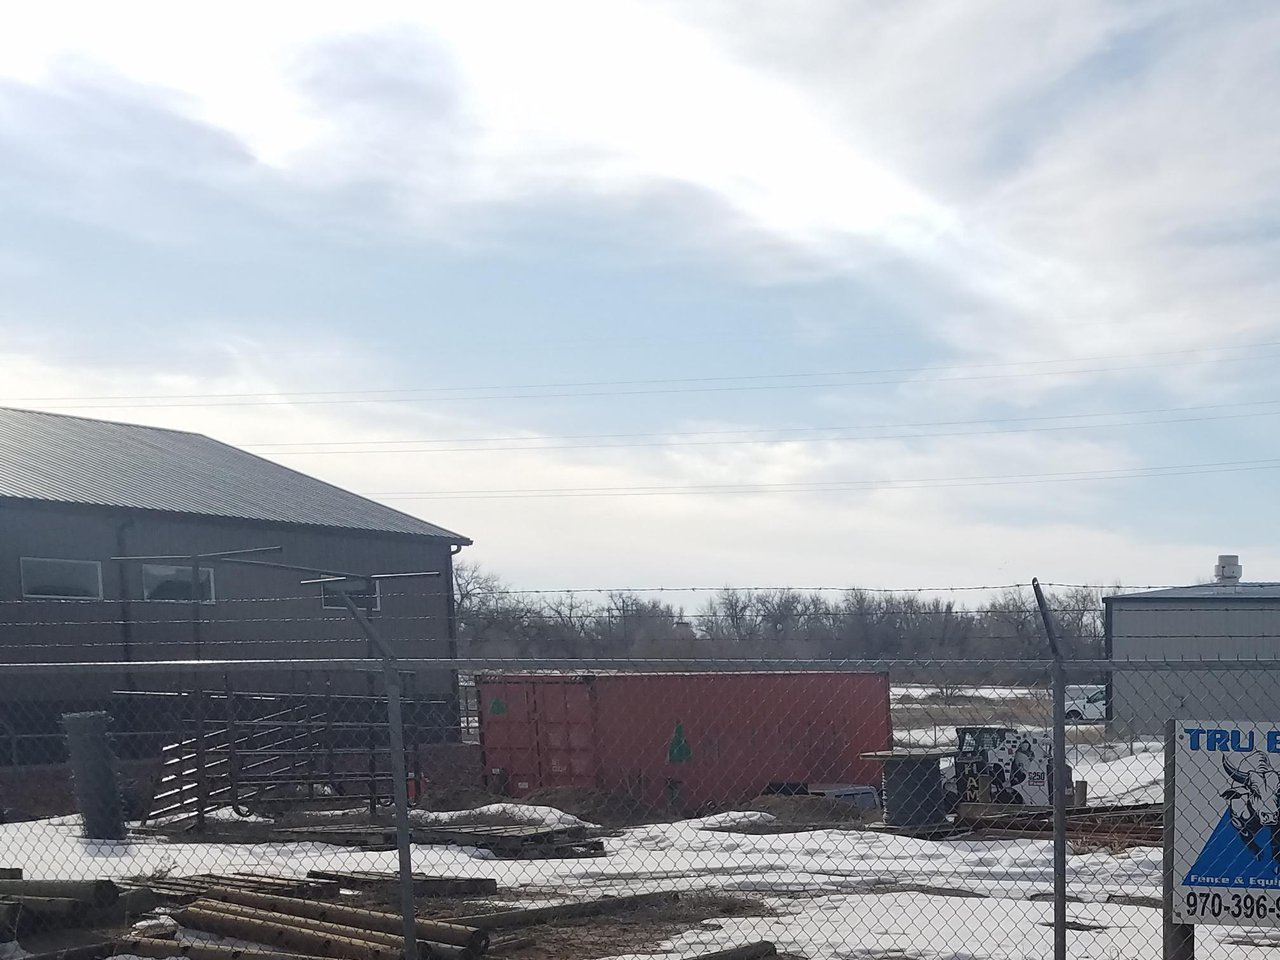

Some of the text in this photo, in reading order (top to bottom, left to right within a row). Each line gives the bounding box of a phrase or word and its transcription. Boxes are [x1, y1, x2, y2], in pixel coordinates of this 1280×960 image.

[1184, 728, 1255, 752] TRU
[1190, 874, 1230, 884] Fence
[1234, 876, 1245, 885] &
